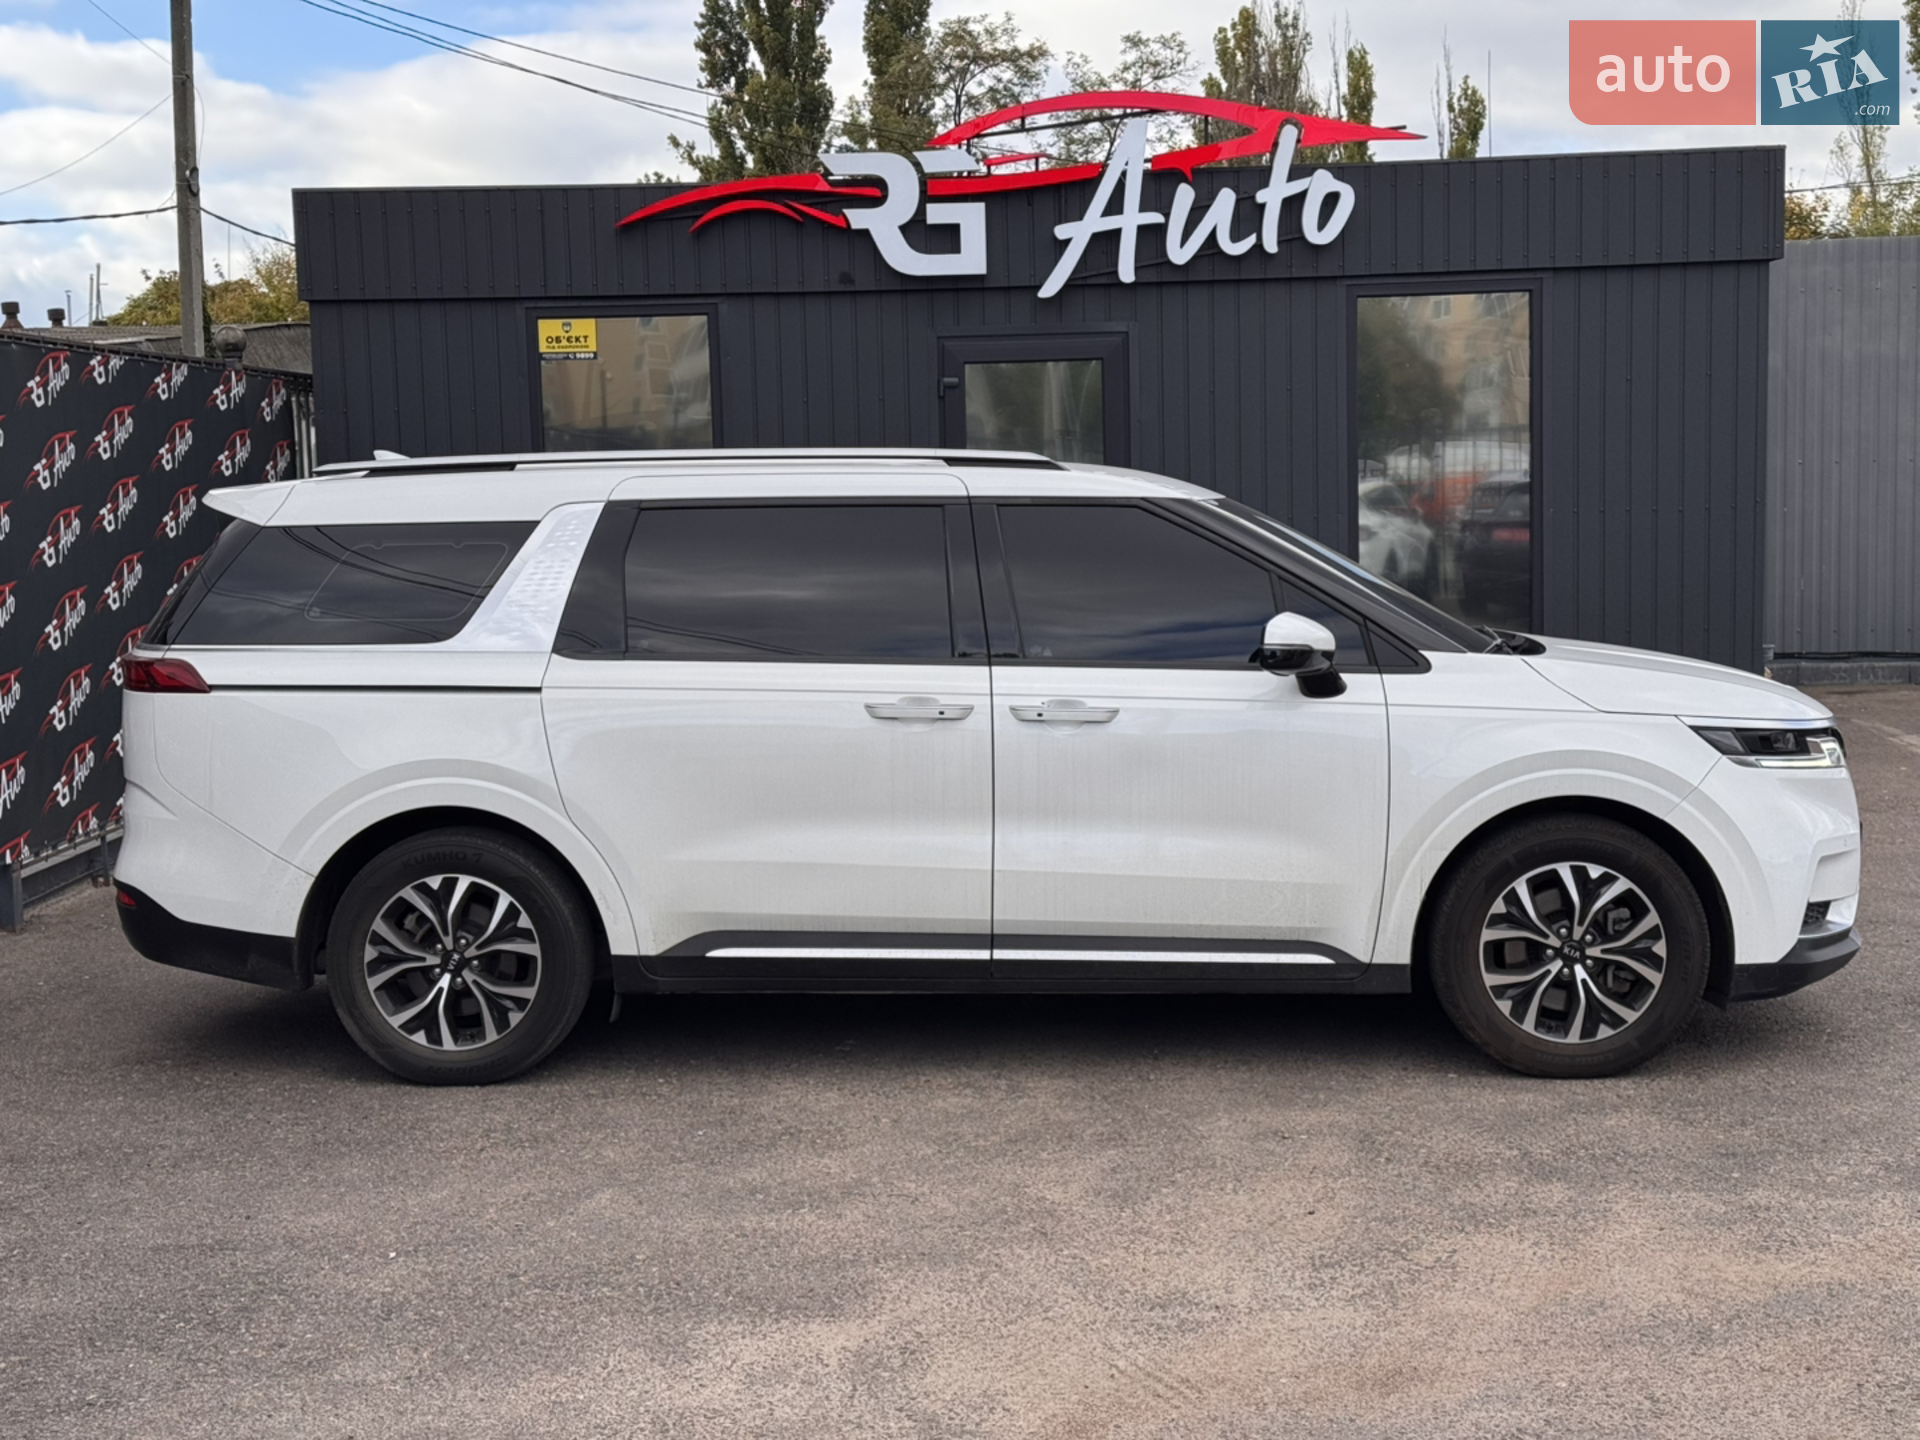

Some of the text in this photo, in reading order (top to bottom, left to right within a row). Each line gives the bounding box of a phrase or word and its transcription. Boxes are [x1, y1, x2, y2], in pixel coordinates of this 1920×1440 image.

[817, 117, 1356, 300] RG Auto
[545, 335, 589, 345] ОБ'ЄКТ
[46, 353, 70, 406] Auto
[112, 407, 134, 458] Auto
[174, 422, 193, 469] Auto
[235, 431, 251, 474] Auto
[53, 433, 76, 488] Auto
[116, 479, 138, 530] Auto
[178, 487, 197, 535] Auto
[58, 509, 81, 564] Auto
[122, 555, 143, 607] Auto
[63, 590, 86, 646] Auto
[68, 669, 91, 726] Auto
[73, 743, 95, 801] Auto
[446, 953, 461, 971] KIA
[1562, 944, 1581, 959] KIA
